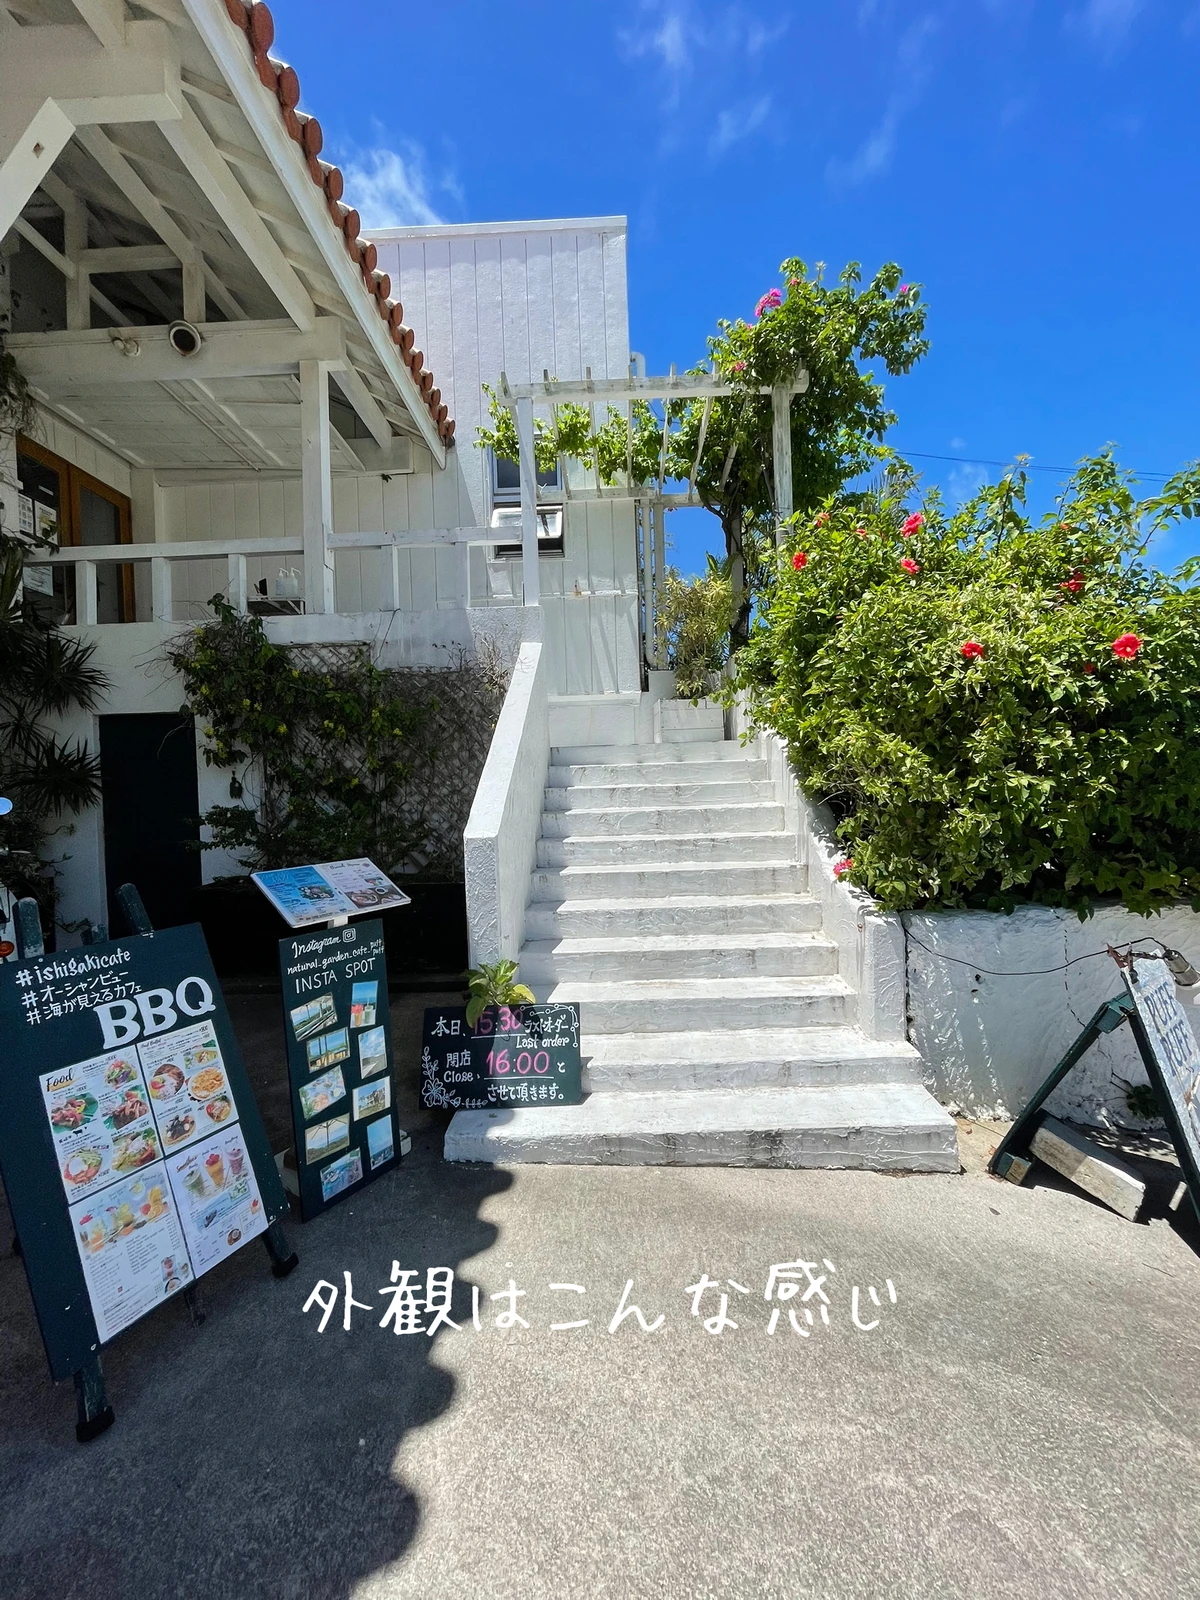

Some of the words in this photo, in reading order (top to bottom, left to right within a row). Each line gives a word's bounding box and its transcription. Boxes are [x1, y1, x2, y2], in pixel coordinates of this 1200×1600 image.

[291, 934, 341, 958] Instagram
[295, 969, 338, 994] INSTA
[345, 957, 376, 979] SPOT
[93, 976, 216, 1050] BBQ
[1144, 981, 1177, 1034] PUFF
[515, 1034, 538, 1049] Last
[541, 1033, 570, 1048] order
[485, 1048, 550, 1076] 16:00
[46, 1067, 73, 1092] Food
